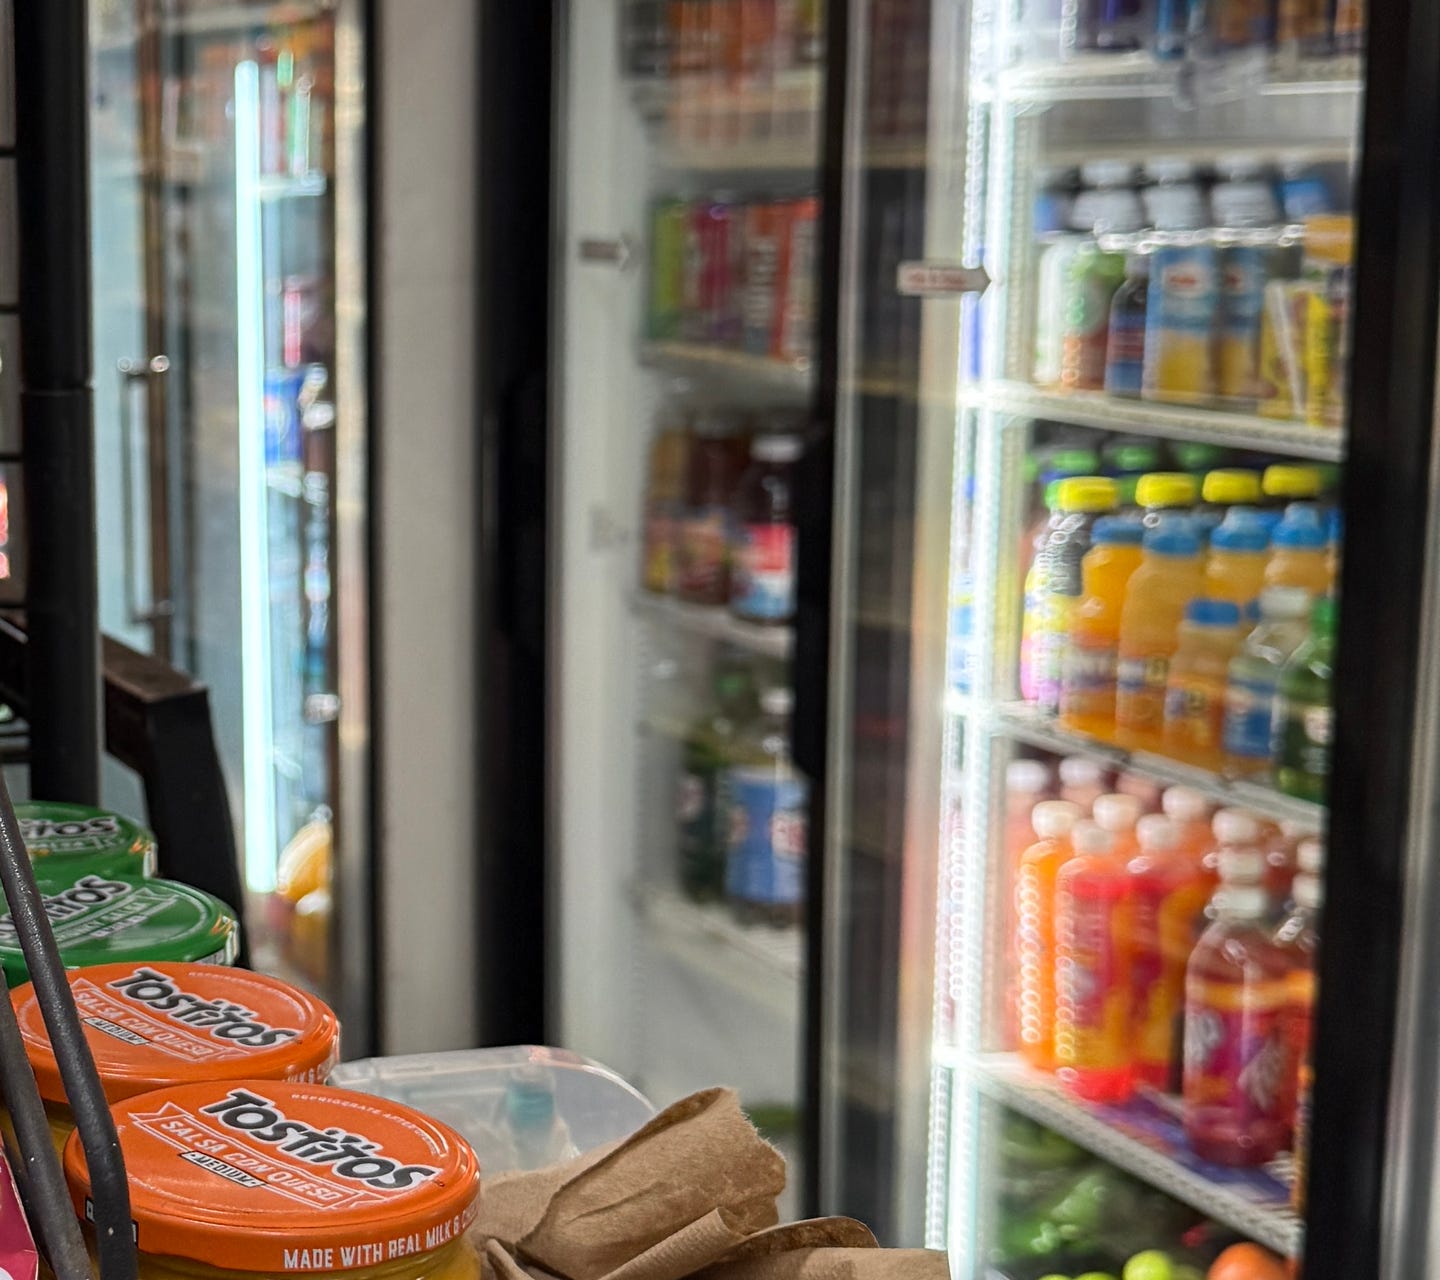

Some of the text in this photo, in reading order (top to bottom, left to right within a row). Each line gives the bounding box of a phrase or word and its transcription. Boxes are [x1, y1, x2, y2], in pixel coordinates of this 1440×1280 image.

[161, 1118, 343, 1202] SALSA CON QUESO
[282, 1223, 452, 1271] MADE WITH REAL MILK
